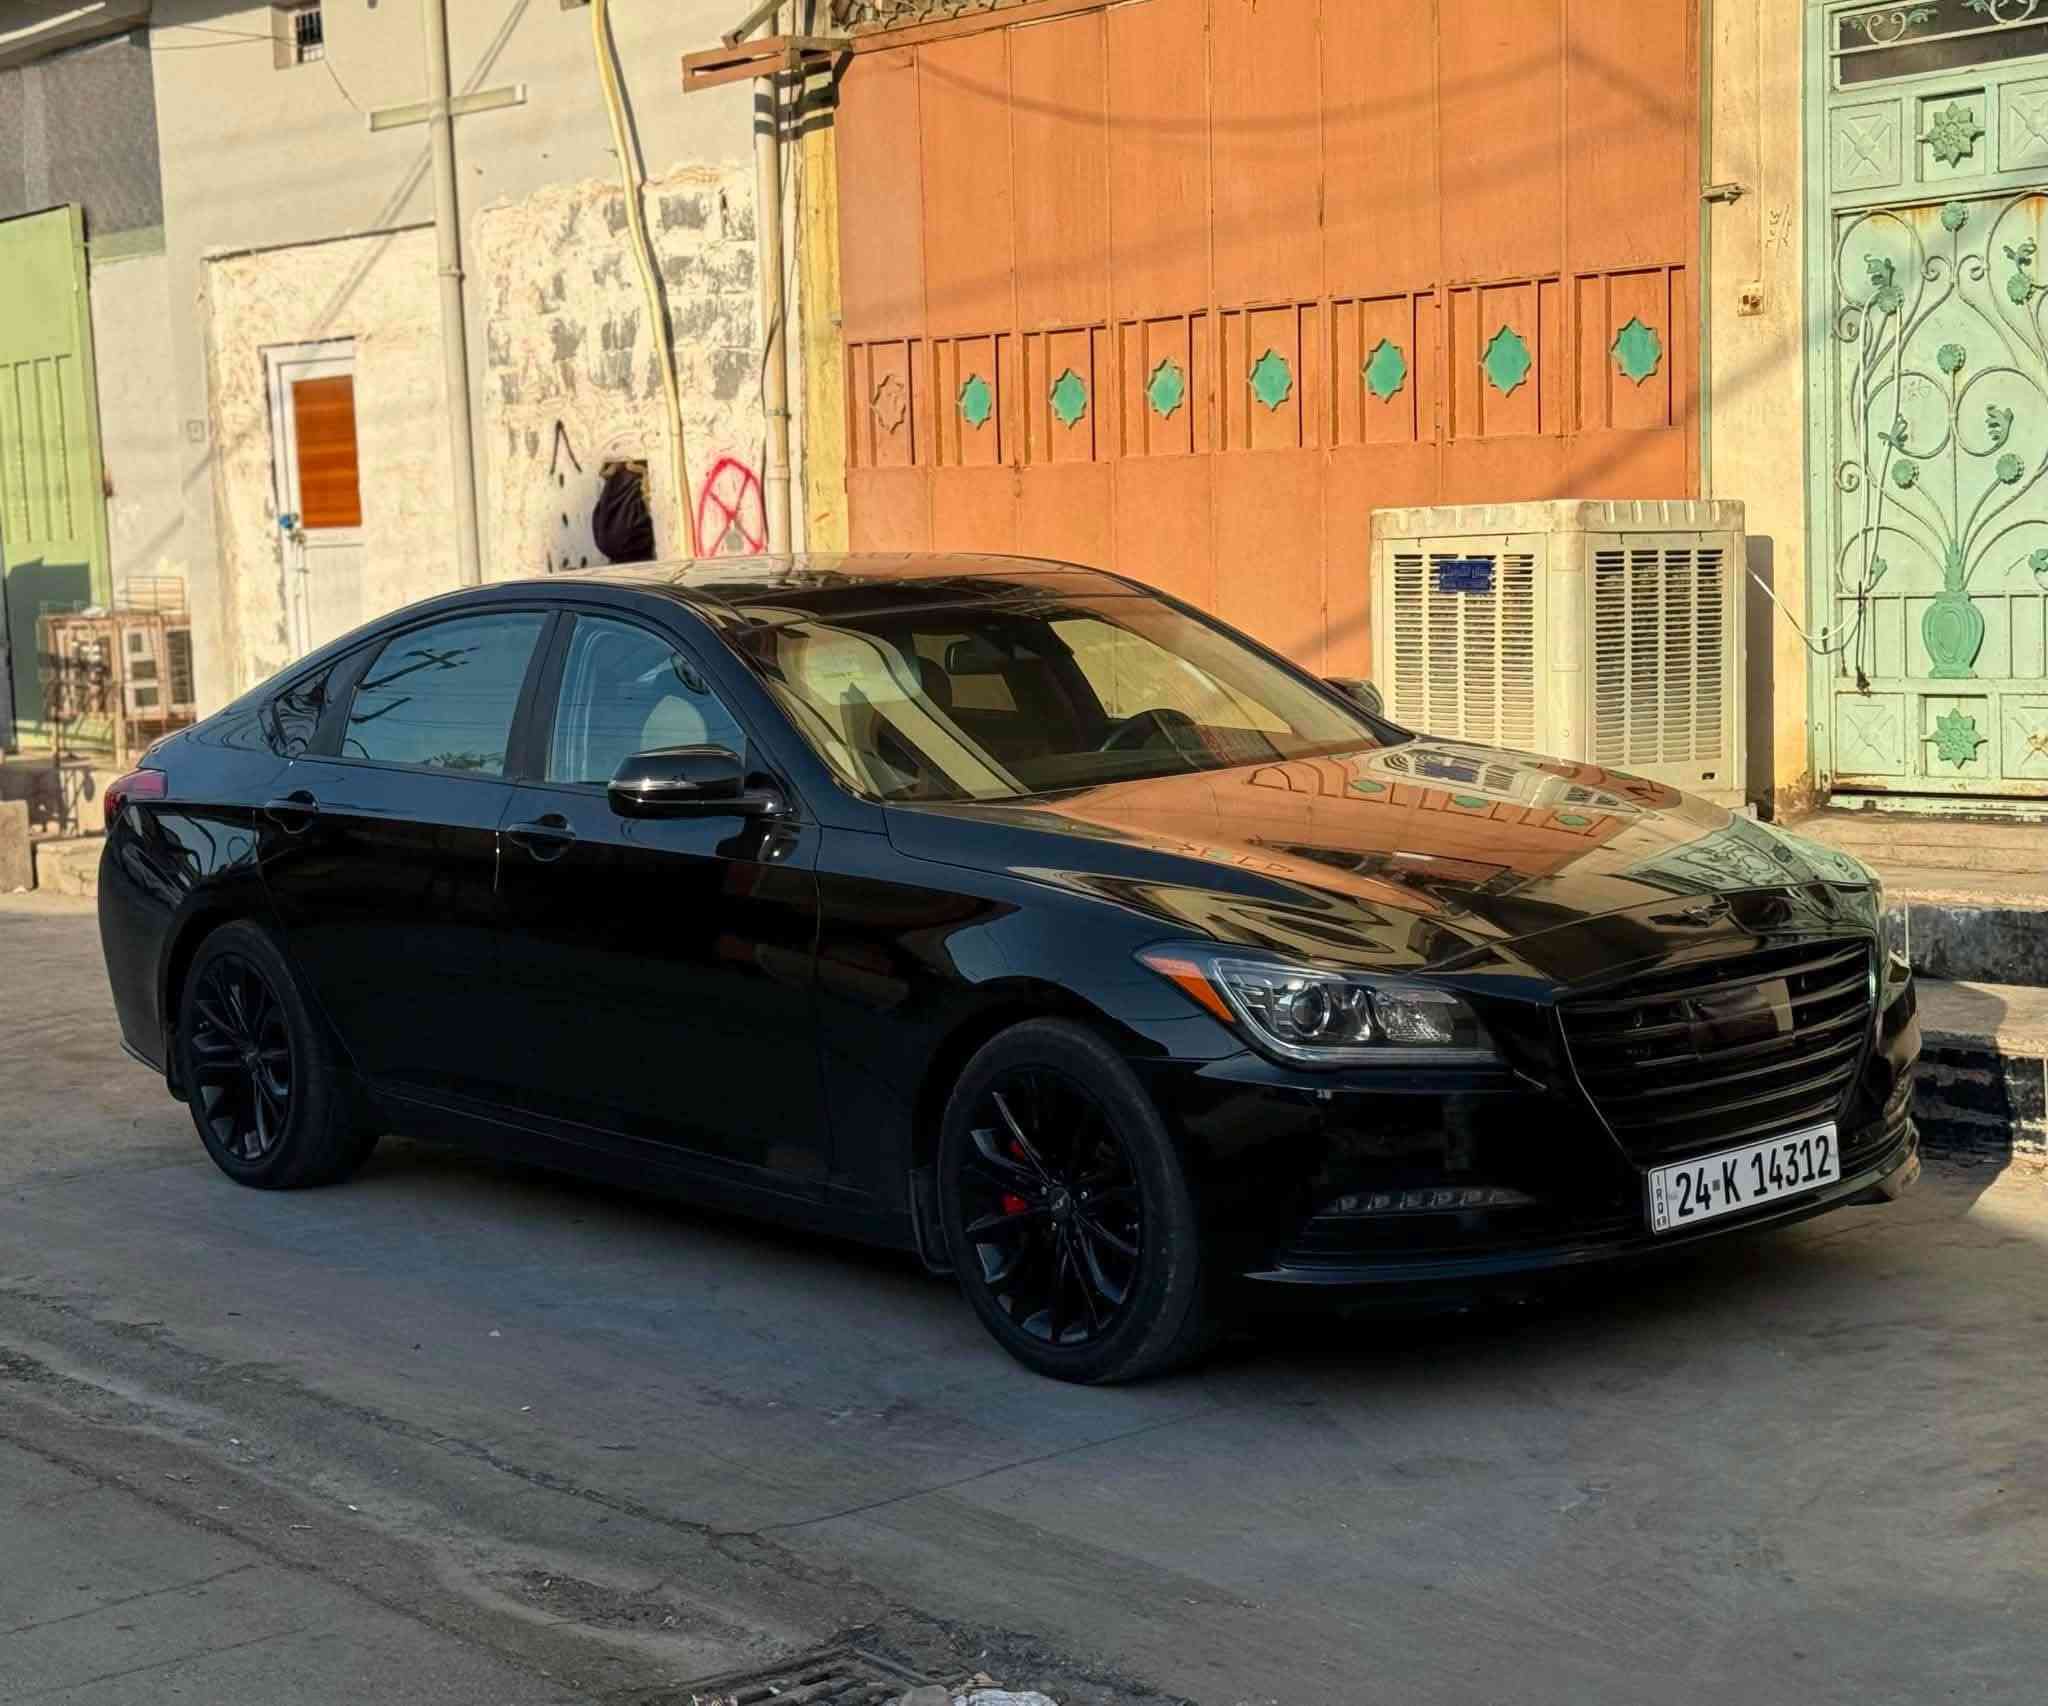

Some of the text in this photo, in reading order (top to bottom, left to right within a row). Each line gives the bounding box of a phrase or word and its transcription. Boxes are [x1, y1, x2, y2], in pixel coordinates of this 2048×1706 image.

[1676, 1135, 1832, 1217] 24 K 14312
